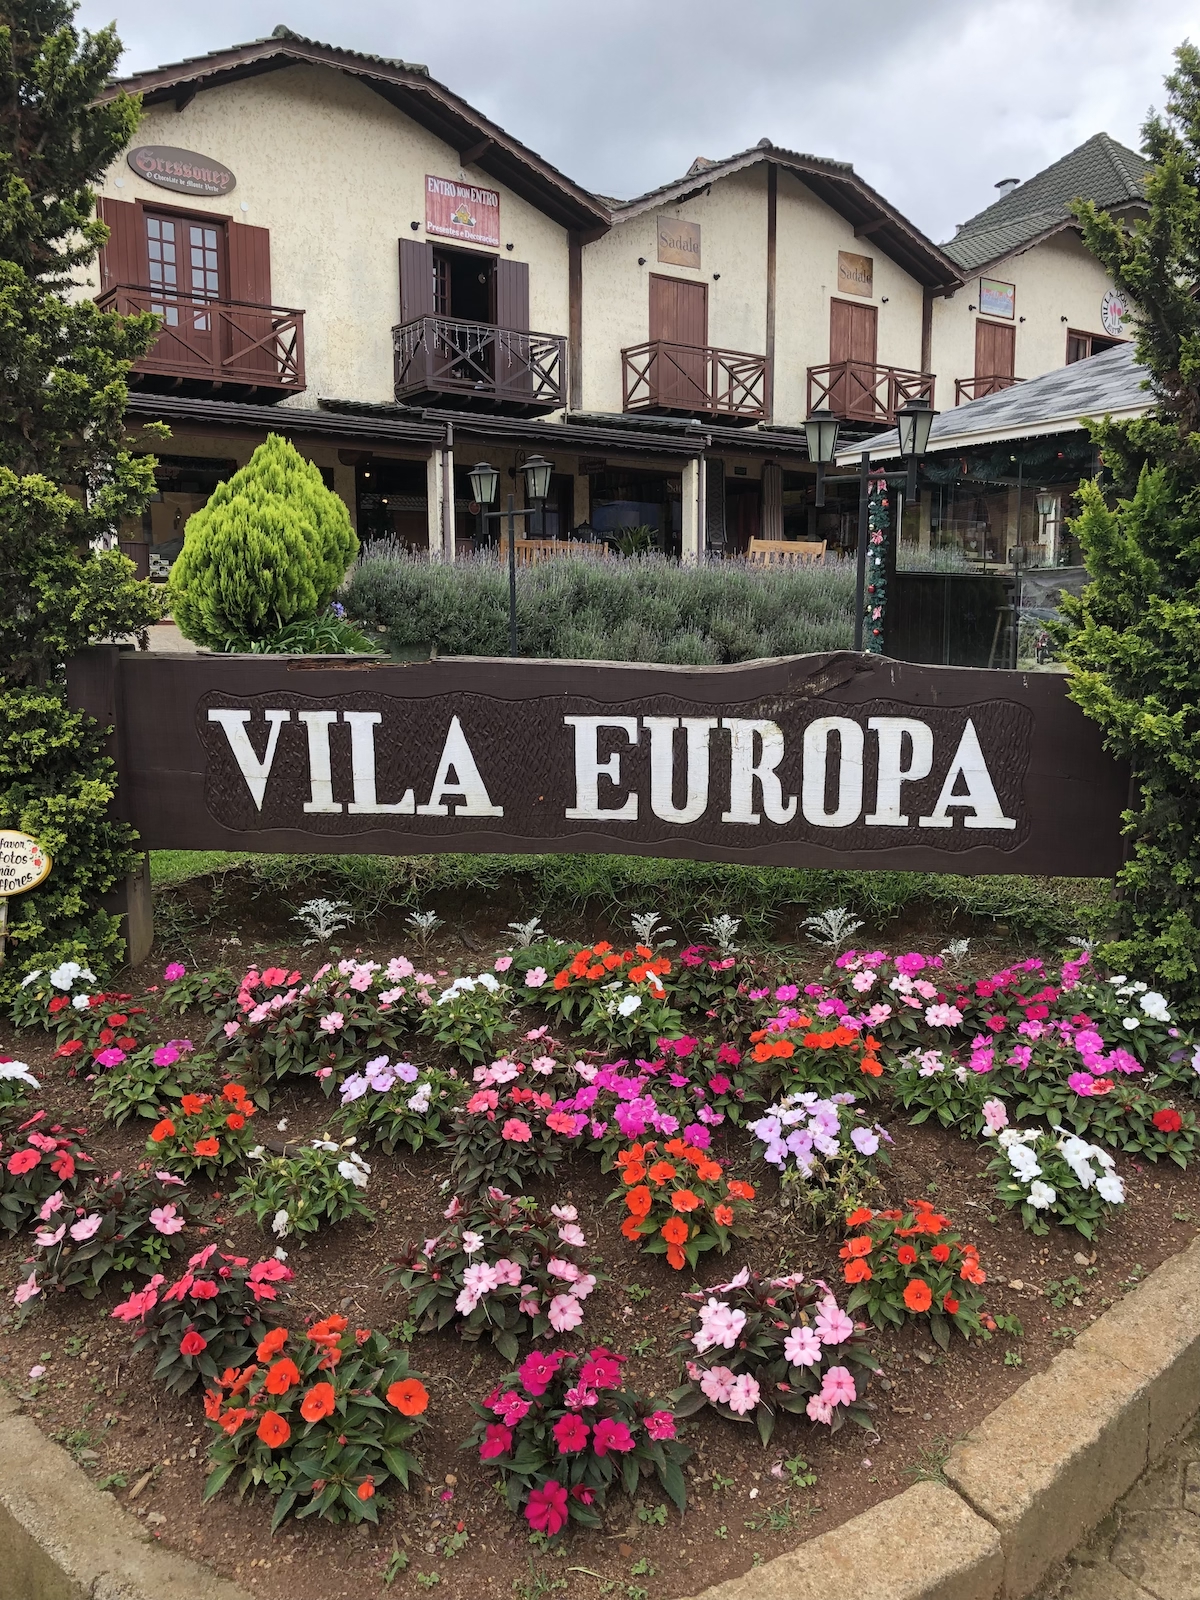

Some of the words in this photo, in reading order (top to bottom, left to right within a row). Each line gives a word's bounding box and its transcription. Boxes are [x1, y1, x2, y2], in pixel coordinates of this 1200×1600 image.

[135, 148, 230, 189] Gressoney
[153, 172, 179, 185] Chocolate
[179, 178, 186, 186] de
[186, 180, 203, 190] Monte
[204, 183, 219, 193] Verde
[427, 177, 456, 197] ENTRO
[470, 188, 498, 207] ENTRO
[427, 221, 459, 236] Presentes
[464, 230, 499, 245] Decorações
[660, 231, 699, 253] Sadale
[840, 264, 872, 284] Sadale
[207, 709, 503, 817] VILA
[563, 715, 1016, 830] EUROPA
